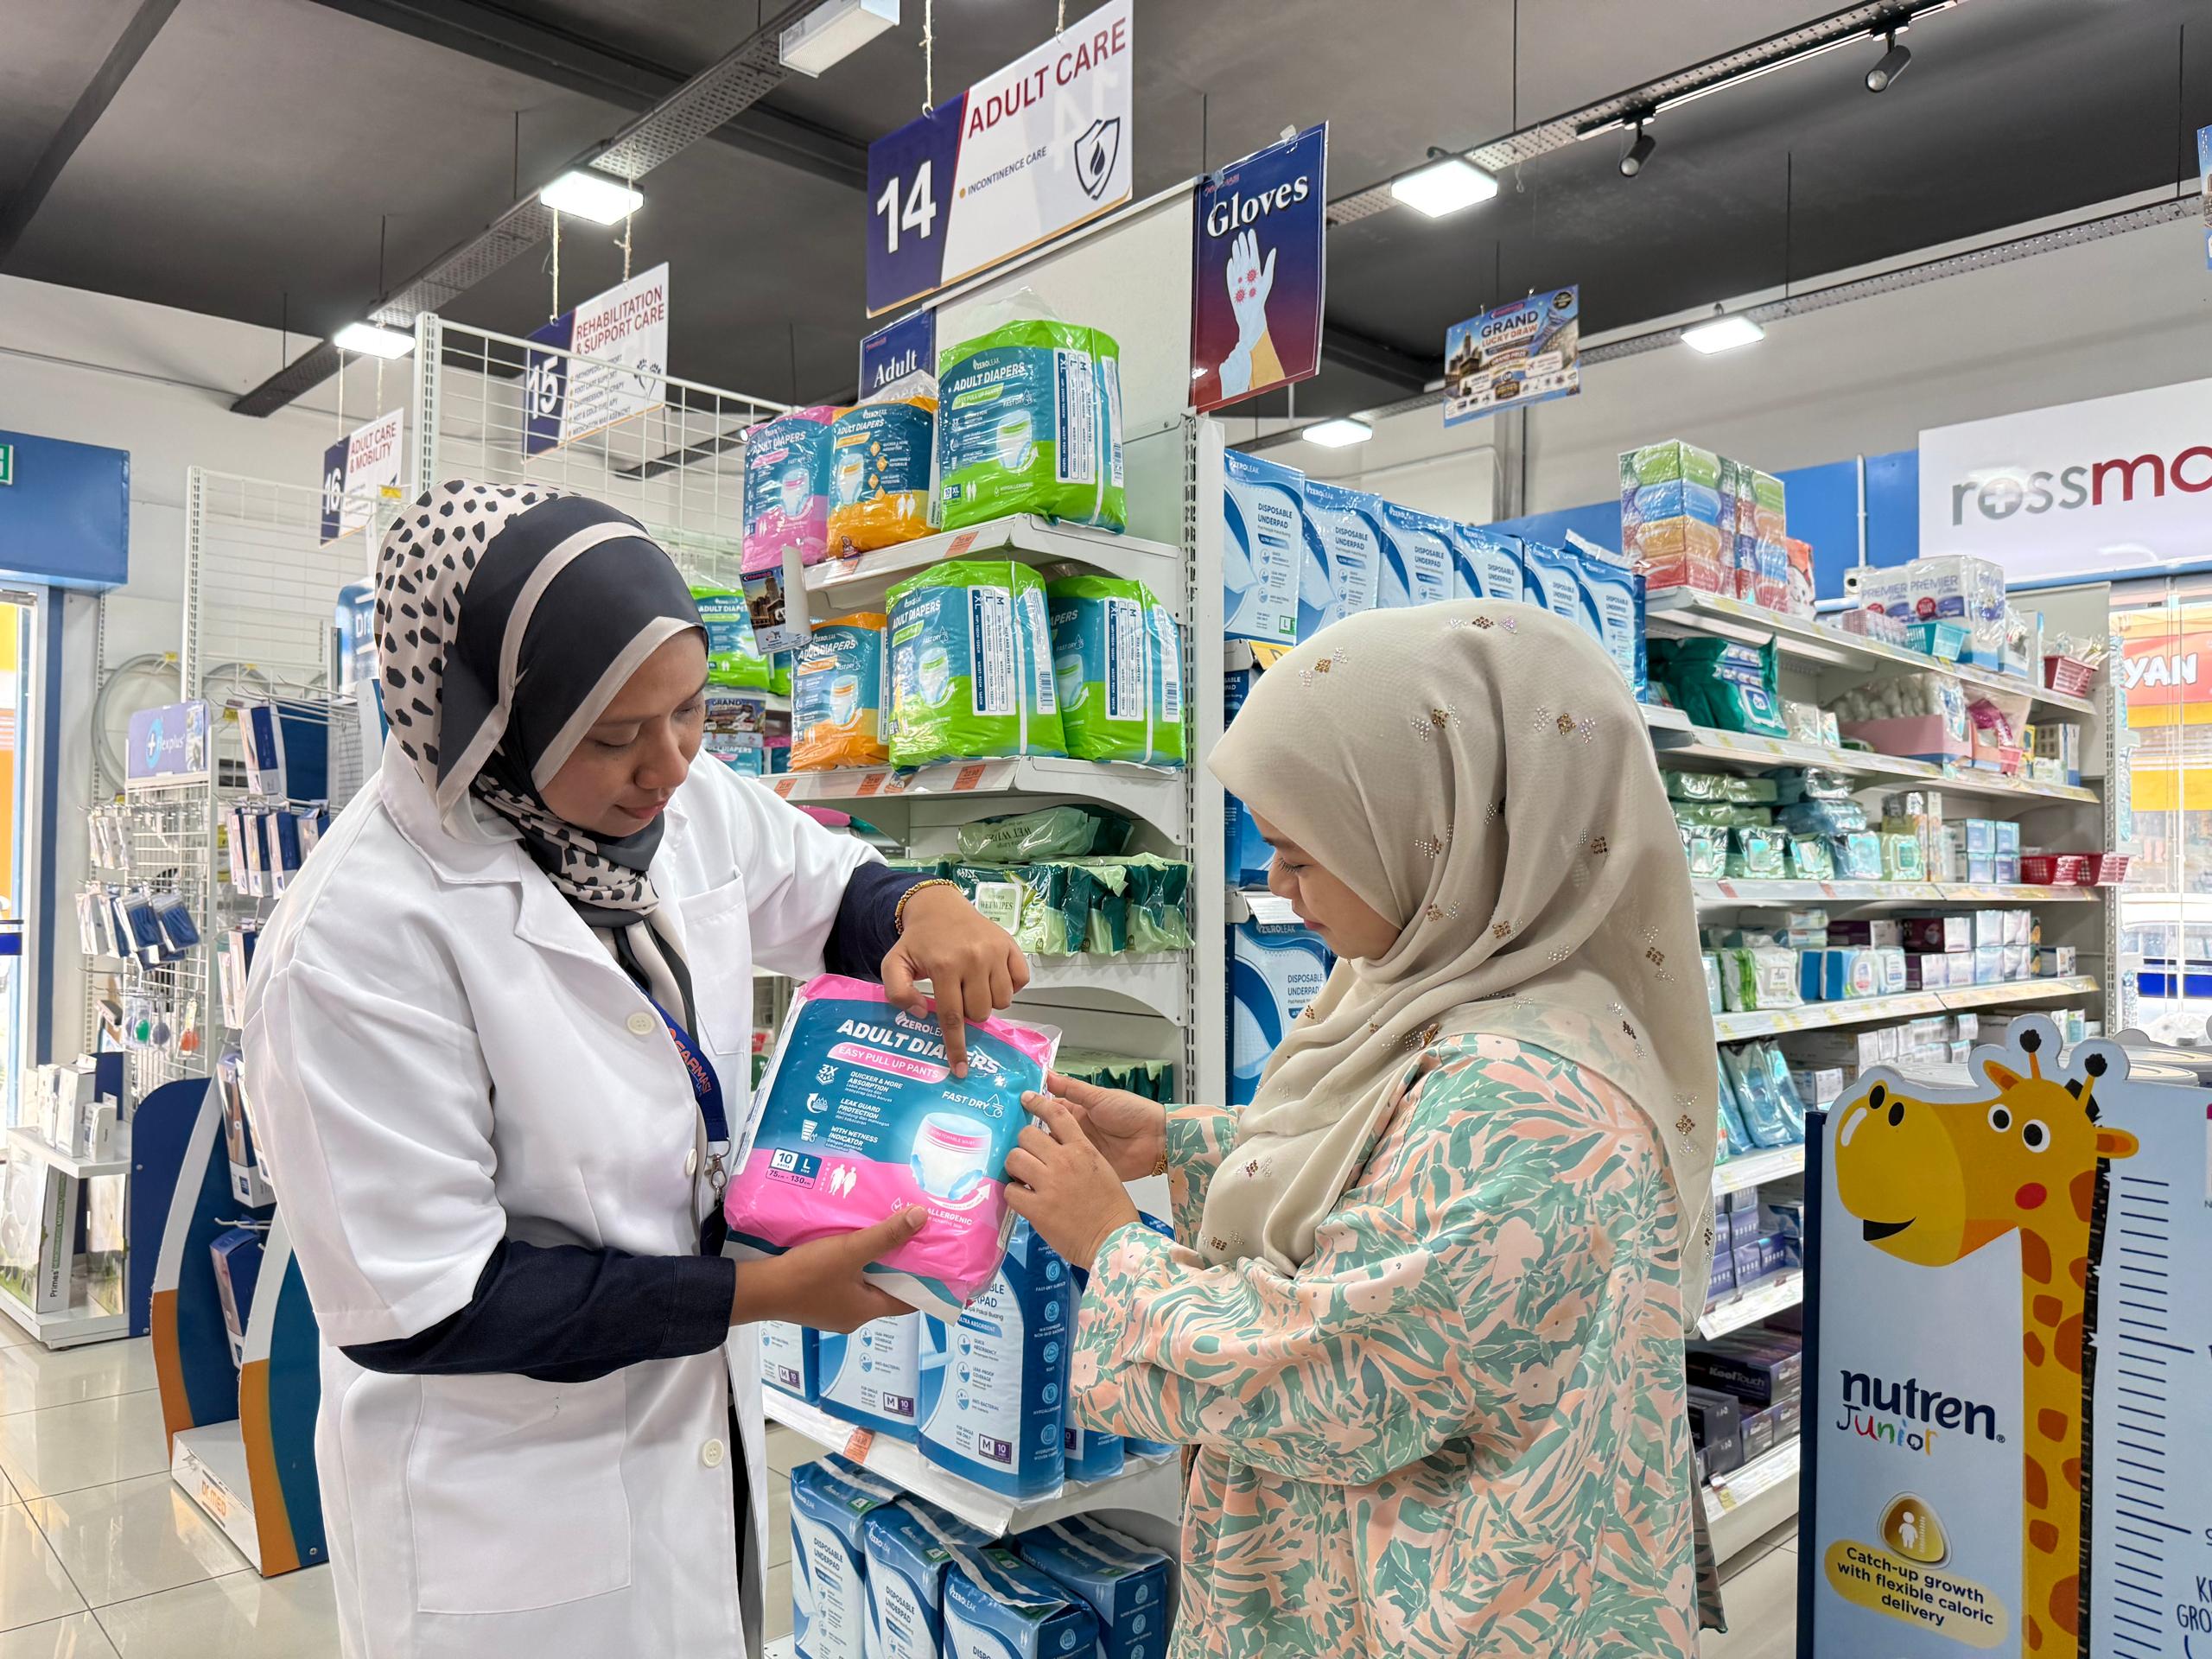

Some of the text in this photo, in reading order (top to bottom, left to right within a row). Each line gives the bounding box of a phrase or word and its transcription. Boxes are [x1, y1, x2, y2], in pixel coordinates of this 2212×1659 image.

[969, 17, 1127, 138] ADULT CARE
[968, 147, 1047, 195] INCONTINENCE CARE
[877, 159, 936, 253] 14
[1207, 176, 1308, 237] Gloves
[576, 285, 663, 340] REHABILITATION
[576, 304, 664, 355] & SUPPORT CARE
[1482, 310, 1539, 338] GRAND
[1482, 334, 1508, 347] LUCKY
[1511, 323, 1538, 338] DRAW
[873, 349, 918, 388] Adult
[976, 358, 1001, 370] ZEROLEAK
[1060, 359, 1067, 373] XL
[1080, 362, 1086, 371] M
[954, 362, 1026, 392] ADULT DIAPERS
[529, 356, 558, 420] 15
[1003, 399, 1014, 408] FAST
[856, 419, 885, 433] DIAPERS
[352, 422, 397, 454] ADULT CARE
[773, 431, 806, 449] DIAPERS
[356, 442, 392, 471] MOBILITY
[1233, 462, 1259, 474] ZEROLEAK
[324, 467, 341, 514] 16
[1258, 503, 1293, 518] DISPOSABLE
[1258, 515, 1287, 529] UNDERPAD
[1336, 527, 1368, 541] DISPOSABLE
[1336, 537, 1365, 550] UNDERPAD
[1414, 546, 1444, 559] DISPOSABLE
[1414, 556, 1440, 568] UNDERPAD
[1488, 563, 1514, 576] DISPOSABLE
[1488, 574, 1512, 583] UNDERPAD
[1910, 575, 1958, 590] PREMIER
[1861, 582, 1908, 598] PREMIER
[975, 596, 982, 609] XL
[1605, 594, 1628, 605] DISPOSABLE
[893, 612, 908, 630] ADULT
[909, 600, 940, 621] DIAPERS
[1051, 610, 1078, 626] APERS
[1110, 606, 1117, 619] XL
[821, 639, 856, 655] DIAPERS
[997, 901, 1014, 910] WIPES
[1261, 925, 1295, 934] ZEROLEAK
[1287, 973, 1323, 983] DISPOSABLE
[1287, 987, 1319, 996] UNDERPAD
[836, 1019, 999, 1074] ADULT DIAERS
[839, 1046, 939, 1078] EASY PULL UP PANTS
[820, 1065, 839, 1076] 3X
[848, 1077, 889, 1092] ABSORPTION
[850, 1071, 878, 1082] QUICKER
[884, 1080, 903, 1089] MORE
[841, 1097, 880, 1112] LEAK GUARD
[942, 1090, 989, 1111] FAST DRY
[838, 1104, 879, 1119] PROTECTION
[829, 1133, 864, 1147] INDICATOR
[849, 1129, 878, 1143] WETNESS
[779, 1153, 810, 1169] 10 L
[50, 1270, 59, 1297] Primes
[988, 1311, 1004, 1321] Buang
[971, 1320, 995, 1332] ABSORBENT
[780, 1368, 787, 1377] M
[1709, 1367, 1764, 1387] KoolTouch
[887, 1396, 895, 1407] M
[1836, 1405, 1937, 1455] Junior
[982, 1440, 1007, 1453] M 10
[814, 1537, 843, 1562] DISPOSABLE
[814, 1548, 840, 1572] UNDERPAD
[1847, 1547, 1984, 1605] Catch-up growth
[886, 1586, 914, 1615] DISPOSABLE
[1837, 1561, 1994, 1624] with flexible caloric
[952, 1592, 976, 1613] ZEROLEAK
[1881, 1594, 1945, 1626] delivery
[886, 1599, 912, 1624] UNDERPAD
[2177, 1605, 2212, 1632] GRO
